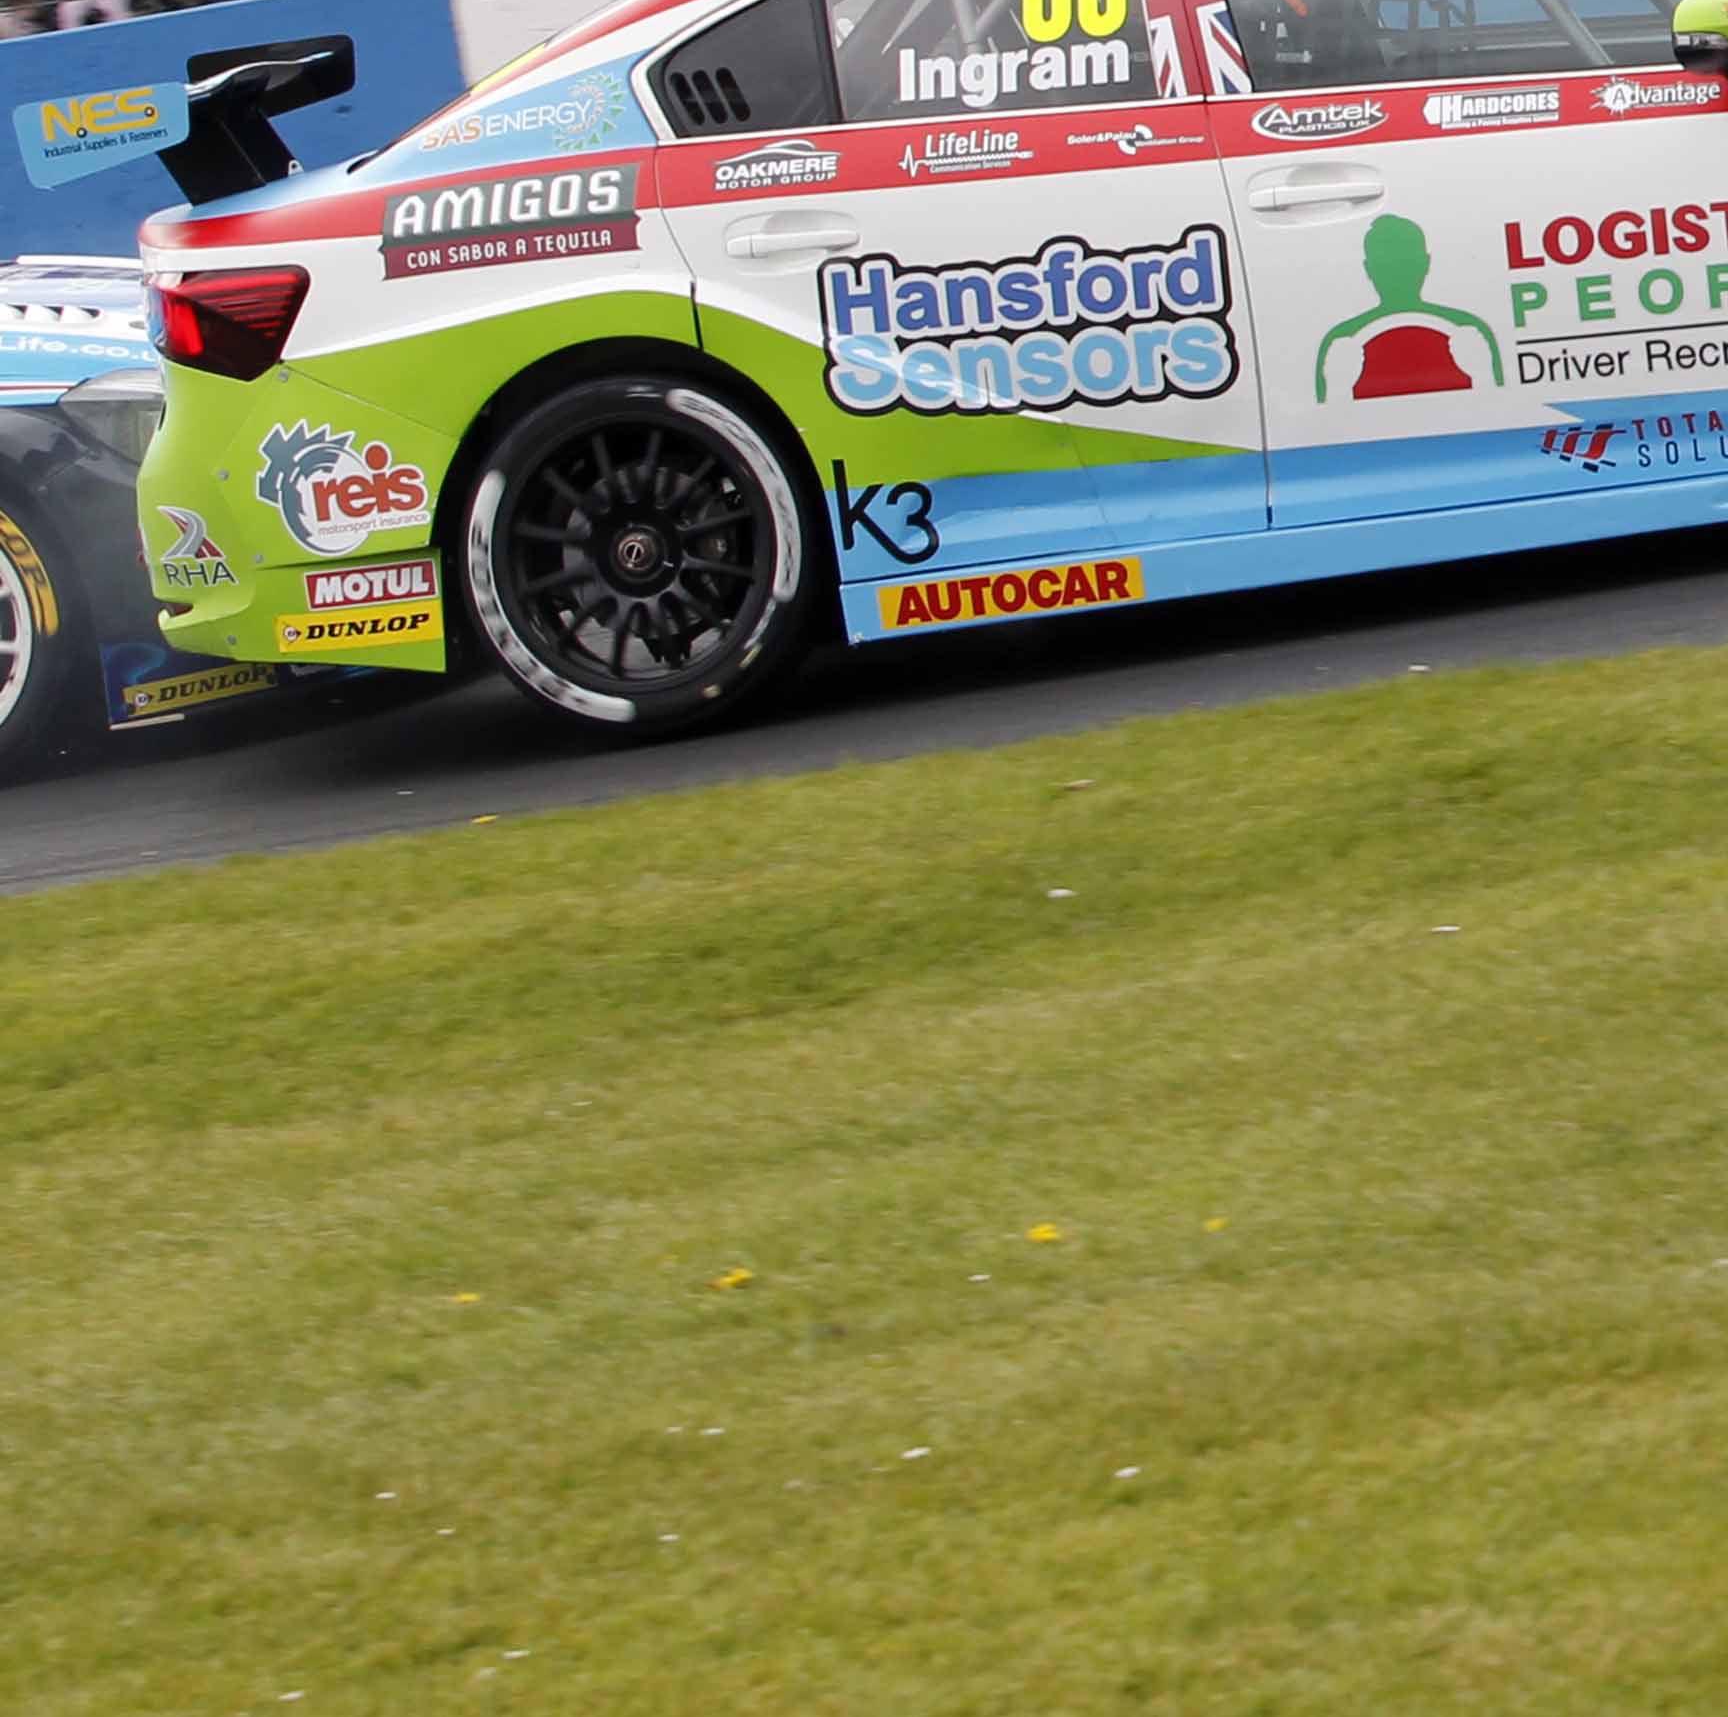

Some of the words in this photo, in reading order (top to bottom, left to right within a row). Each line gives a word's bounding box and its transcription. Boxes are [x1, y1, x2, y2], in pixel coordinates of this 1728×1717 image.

[900, 37, 1131, 108] Ingram
[1442, 91, 1560, 123] HARDCORES
[1612, 82, 1721, 106] Advantage
[1263, 98, 1383, 127] Amtek
[1278, 120, 1346, 135] PLASTICS
[1349, 118, 1371, 129] UK
[44, 140, 82, 159] Industrial
[84, 135, 118, 151] Supplies
[925, 129, 1019, 159] LifeLine
[715, 152, 839, 182] OAKMERE
[715, 177, 774, 190] MOTOR
[780, 171, 838, 186] GROUP
[392, 169, 622, 238] AMIGOS
[406, 249, 441, 269] CON
[448, 241, 508, 264] SABOR
[516, 238, 527, 255] A
[534, 229, 612, 253] TEQUILA
[830, 237, 1218, 336] Hansford
[835, 323, 1226, 405] Sensors
[1517, 340, 1630, 384] Driver
[311, 443, 427, 523] reis
[318, 521, 378, 538] motorsport
[379, 512, 429, 528] insurance
[163, 560, 239, 588] RHA
[314, 565, 432, 606] MOTUL
[895, 561, 1132, 627] AUTOCAR
[305, 613, 430, 640] DUNLOP
[157, 666, 270, 703] DUNLOP
